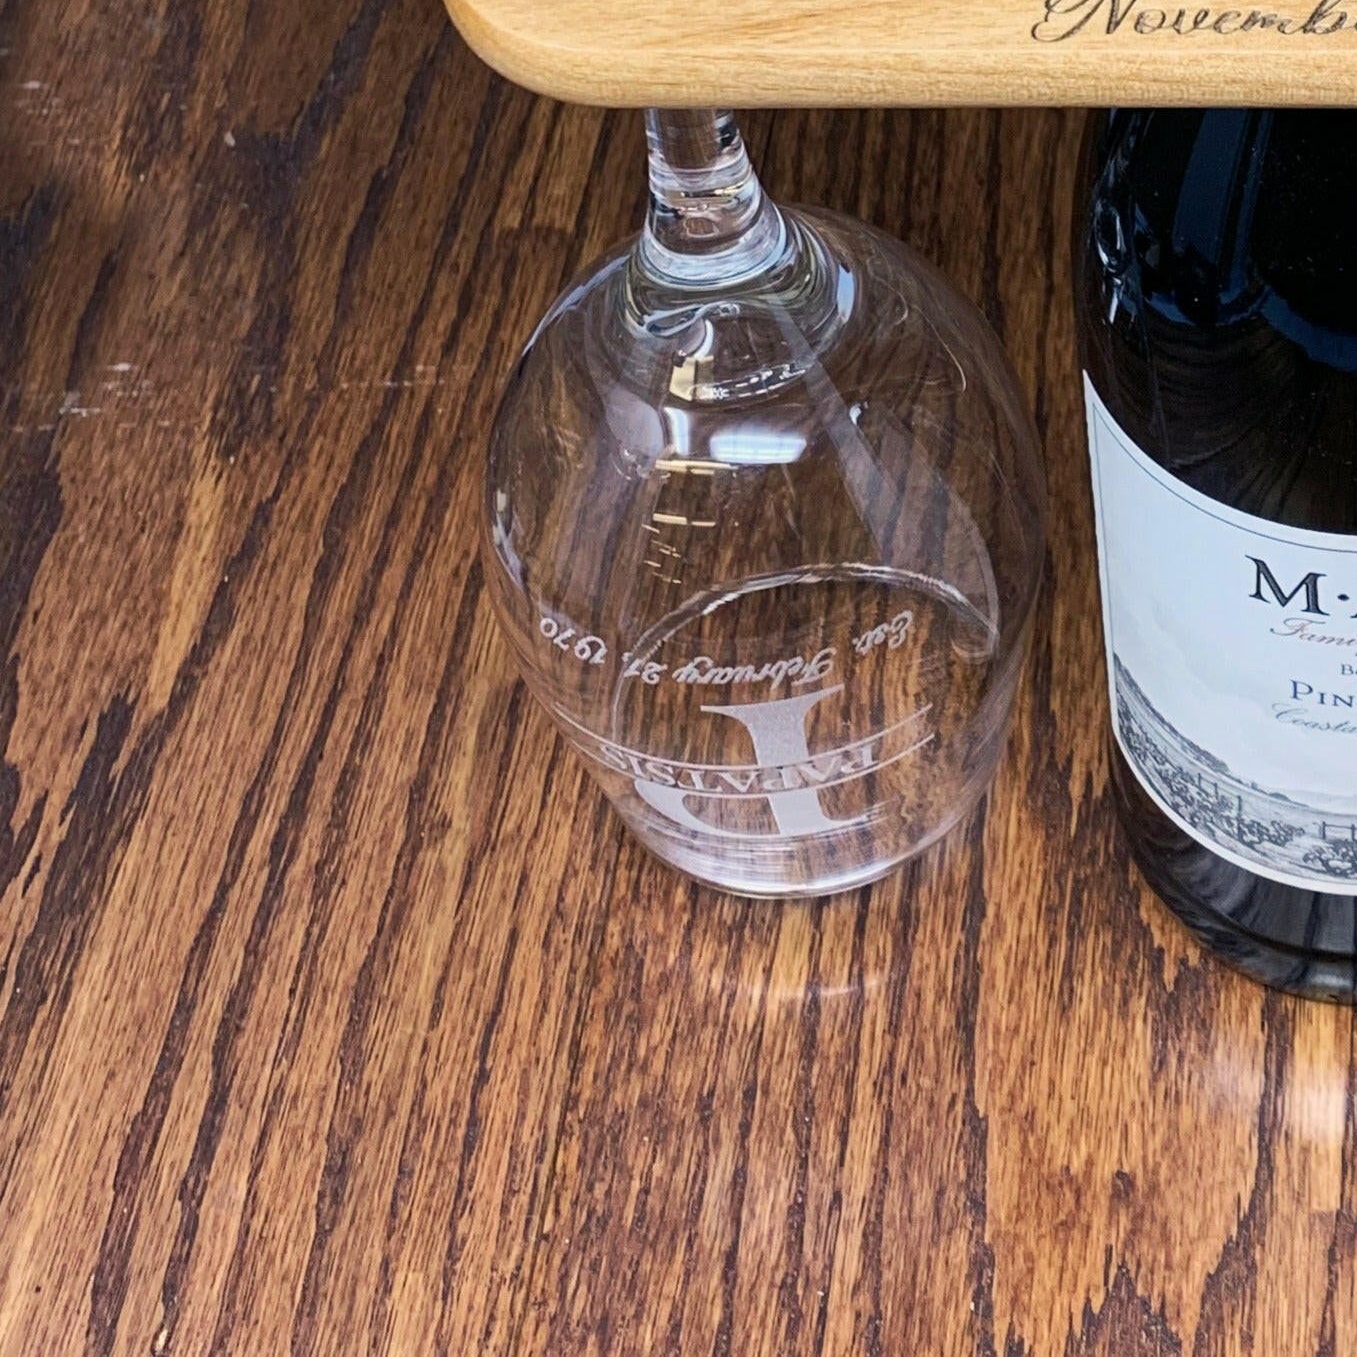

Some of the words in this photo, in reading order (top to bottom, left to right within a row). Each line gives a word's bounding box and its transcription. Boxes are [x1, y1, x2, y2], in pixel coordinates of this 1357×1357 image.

[538, 616, 607, 667] 1970
[671, 646, 839, 688] February
[603, 742, 878, 795] PAPATSIS
